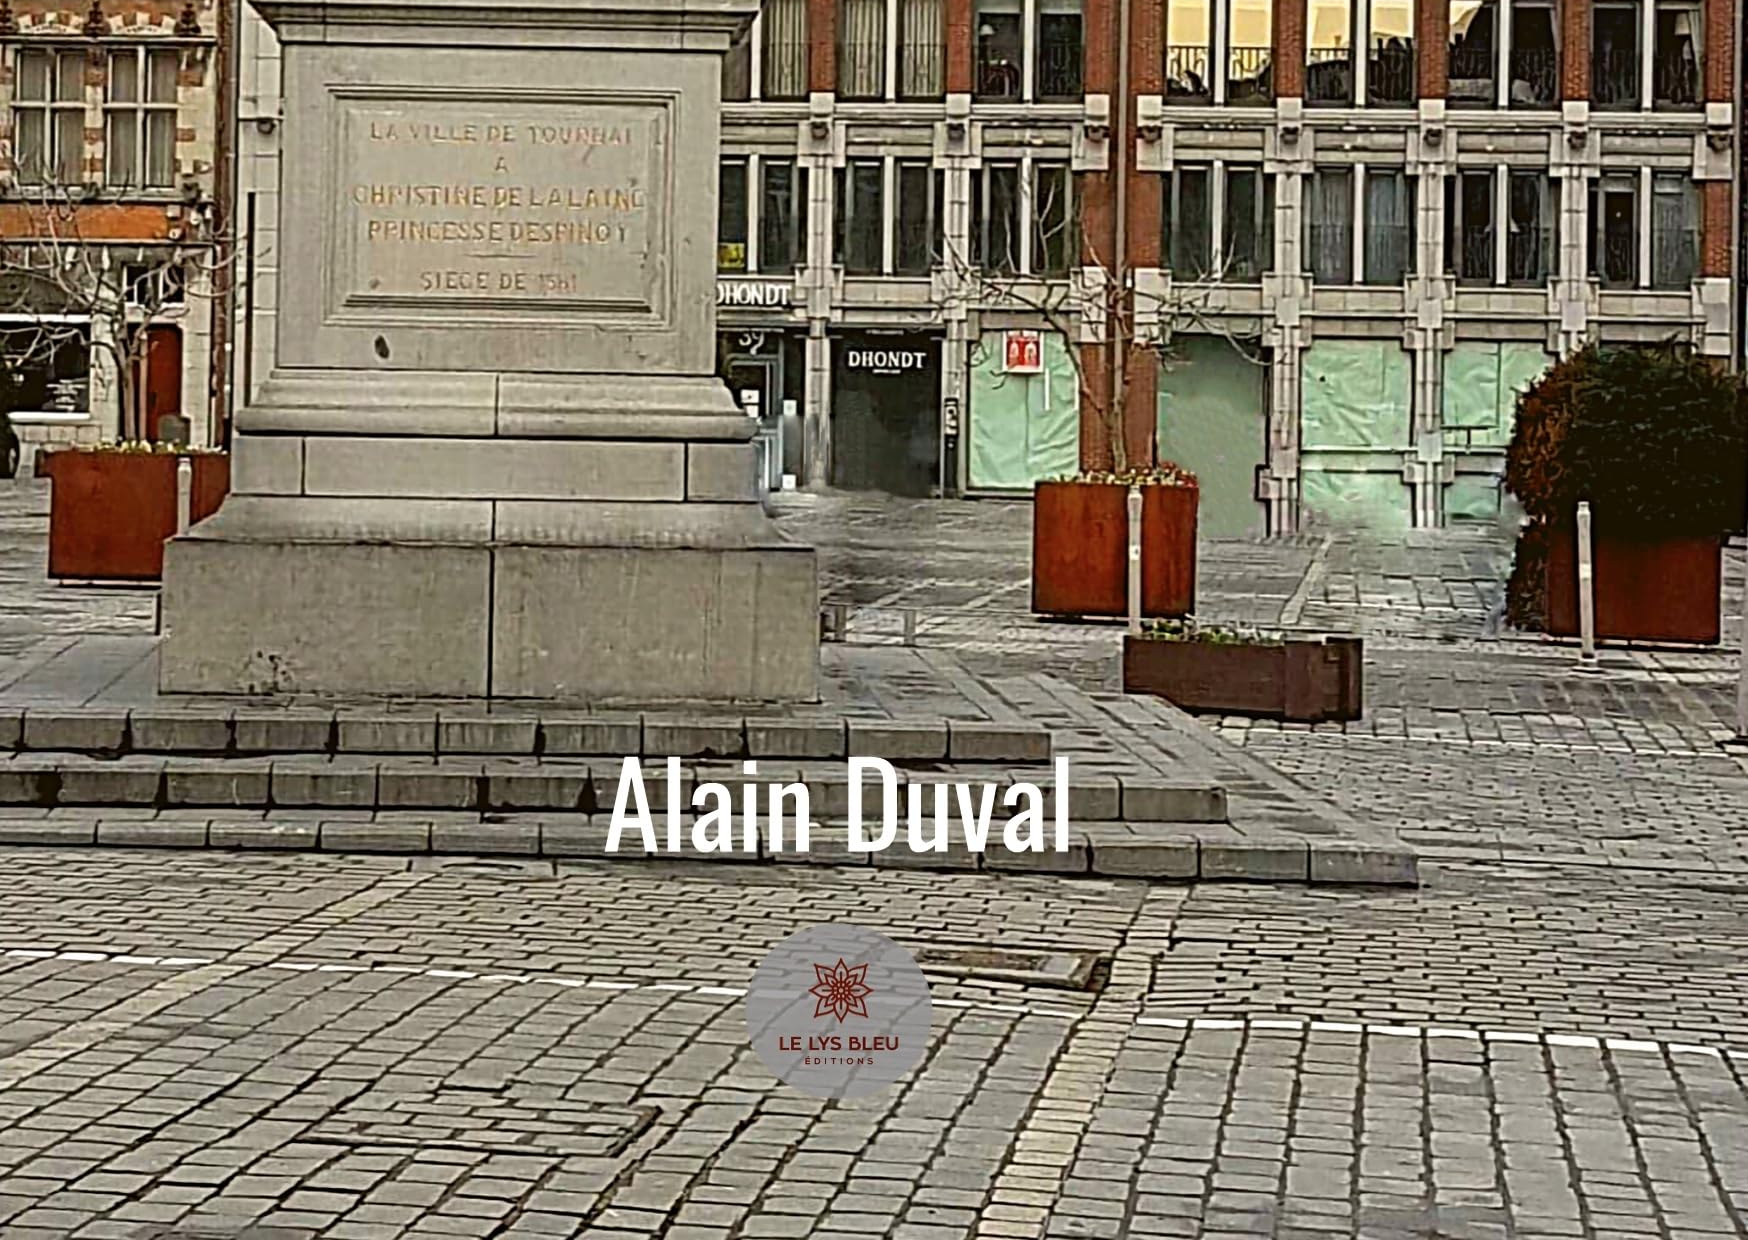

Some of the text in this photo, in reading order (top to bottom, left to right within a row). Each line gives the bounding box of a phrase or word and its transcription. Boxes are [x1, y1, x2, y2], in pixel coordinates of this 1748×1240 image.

[370, 121, 398, 141] LA
[409, 123, 477, 142] VILLE
[487, 125, 516, 143] DE
[500, 272, 527, 291] DE
[847, 350, 927, 369] DHONDT
